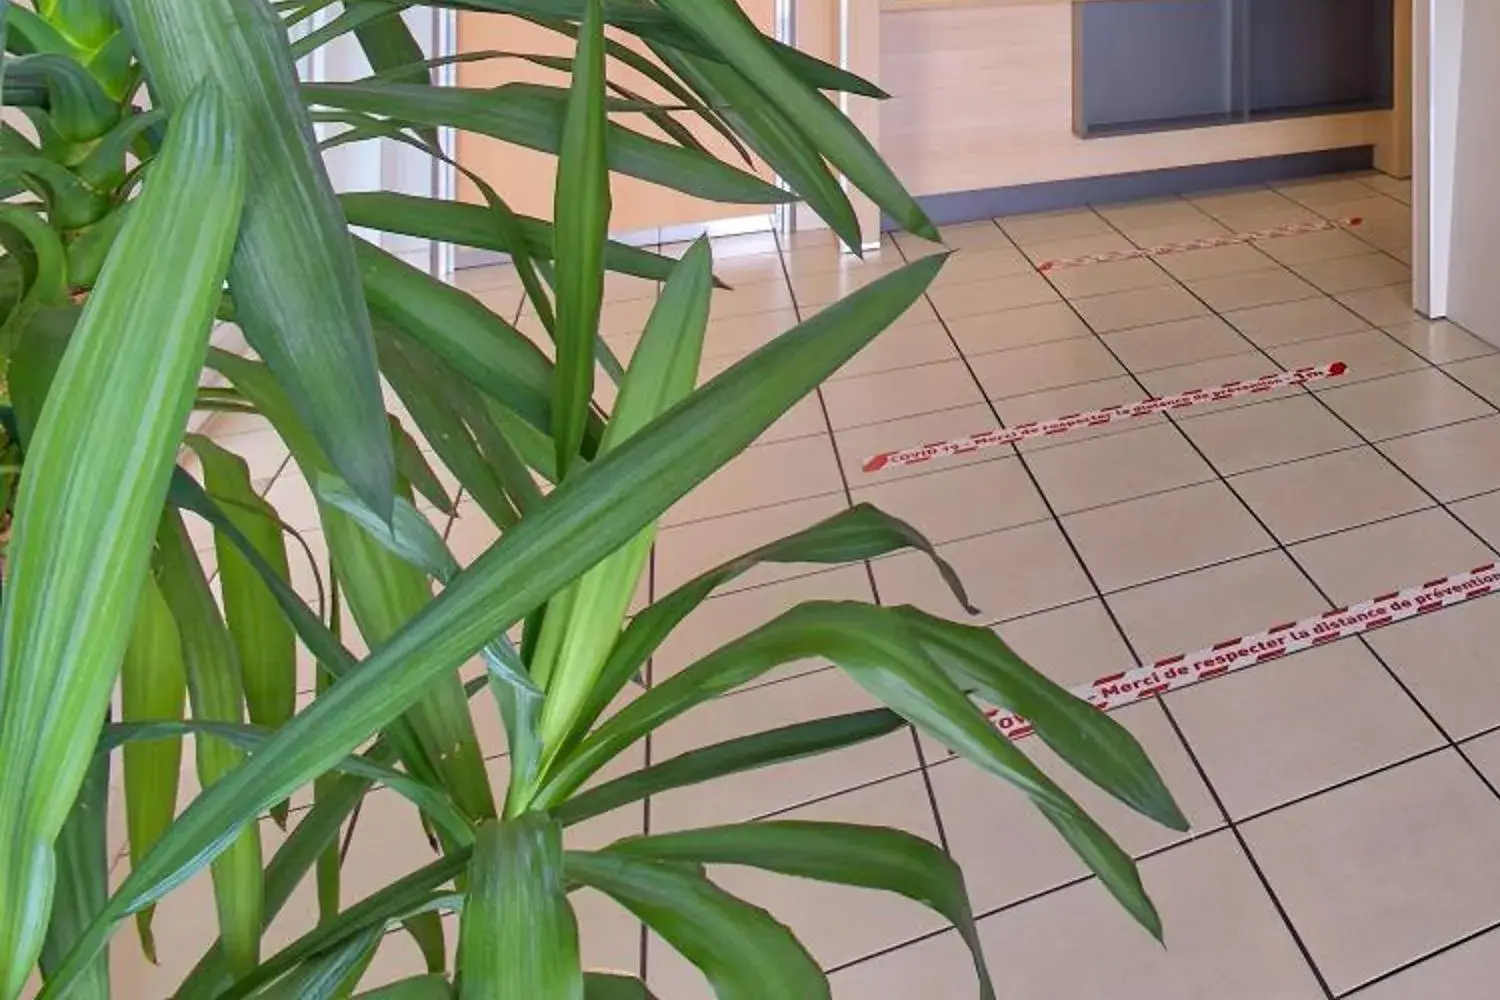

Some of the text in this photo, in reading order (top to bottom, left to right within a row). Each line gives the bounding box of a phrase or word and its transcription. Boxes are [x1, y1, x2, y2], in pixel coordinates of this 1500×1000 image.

[1100, 672, 1161, 698] Merci
[1162, 666, 1189, 685] de
[1193, 636, 1287, 671] respecter
[1291, 629, 1310, 643] la
[1312, 605, 1388, 637] distance
[1390, 599, 1412, 613] de
